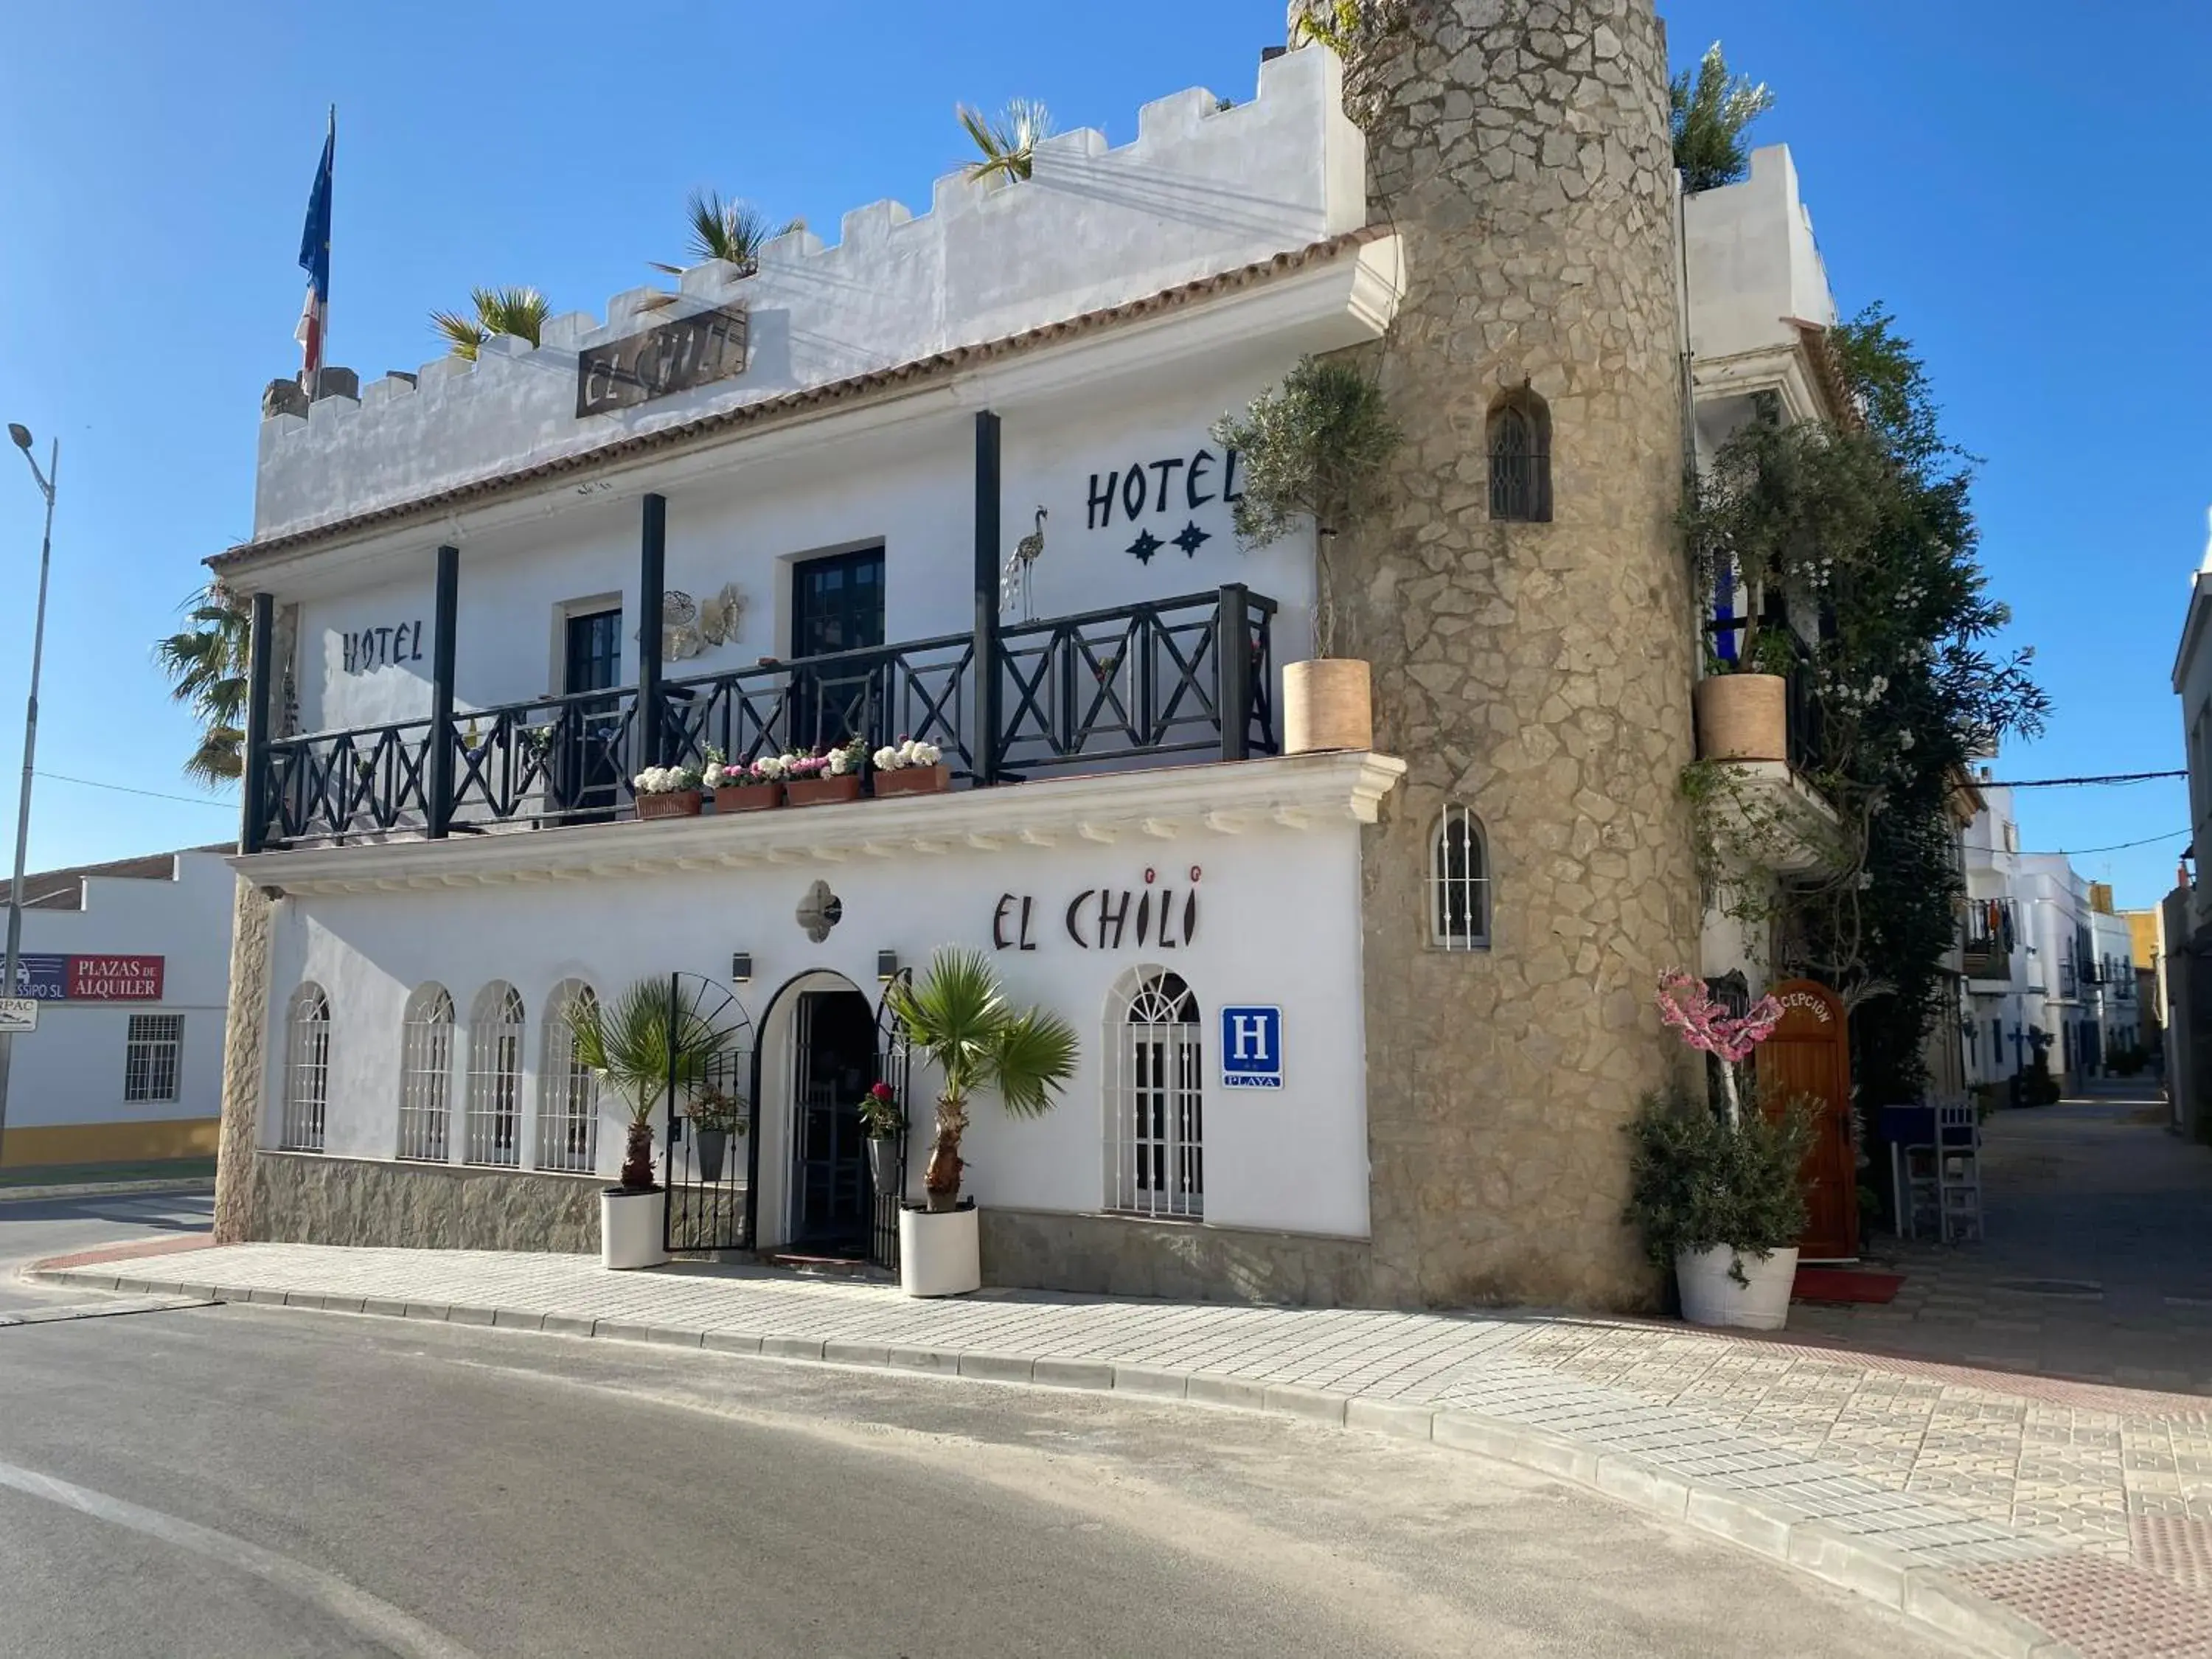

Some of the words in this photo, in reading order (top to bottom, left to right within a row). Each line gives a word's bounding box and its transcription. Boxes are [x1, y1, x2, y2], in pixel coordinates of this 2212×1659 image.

[1088, 448, 1243, 529] HOTEL
[343, 620, 422, 673] HOTEL
[993, 893, 1035, 950] EL
[1066, 865, 1202, 949] CHILI
[78, 960, 139, 977] PLAZAS
[142, 967, 157, 977] DE
[49, 984, 65, 998] SL
[74, 979, 155, 998] ALQUILER
[1781, 992, 1829, 1023] CEPCIÓN
[1233, 1015, 1269, 1060] H
[1228, 1076, 1275, 1086] PLAYA
